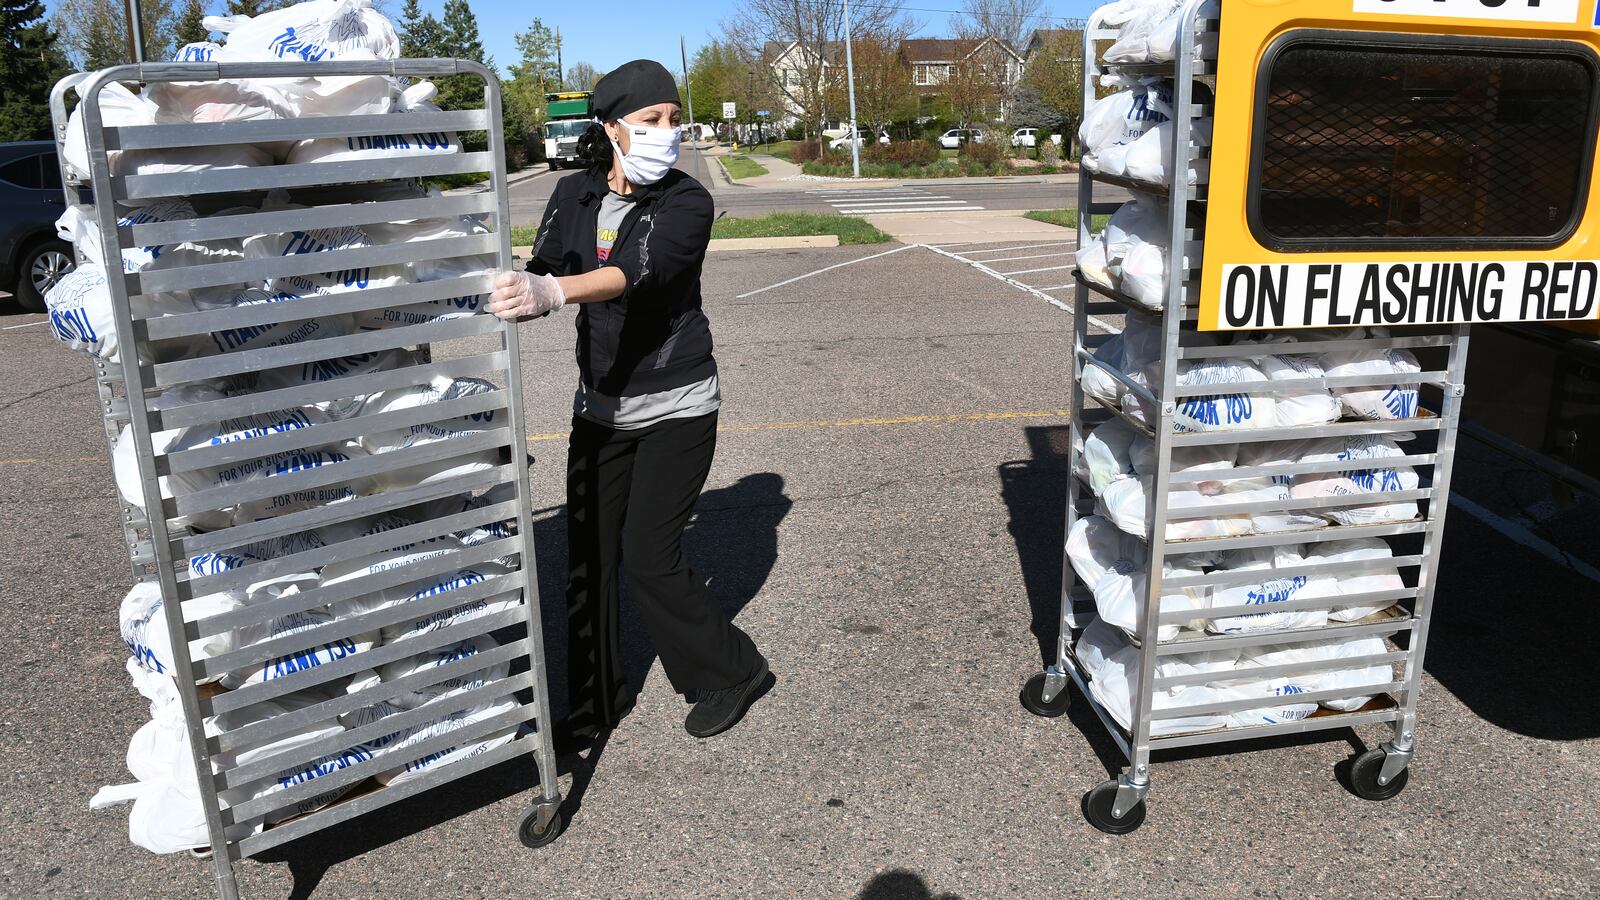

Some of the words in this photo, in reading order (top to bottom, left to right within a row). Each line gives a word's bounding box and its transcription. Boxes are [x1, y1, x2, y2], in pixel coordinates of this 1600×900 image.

[1225, 264, 1289, 327] ON
[1303, 262, 1505, 326] FLASHING
[1519, 261, 1599, 321] RED
[1225, 392, 1253, 424] YOU
[293, 490, 316, 503] YOUR
